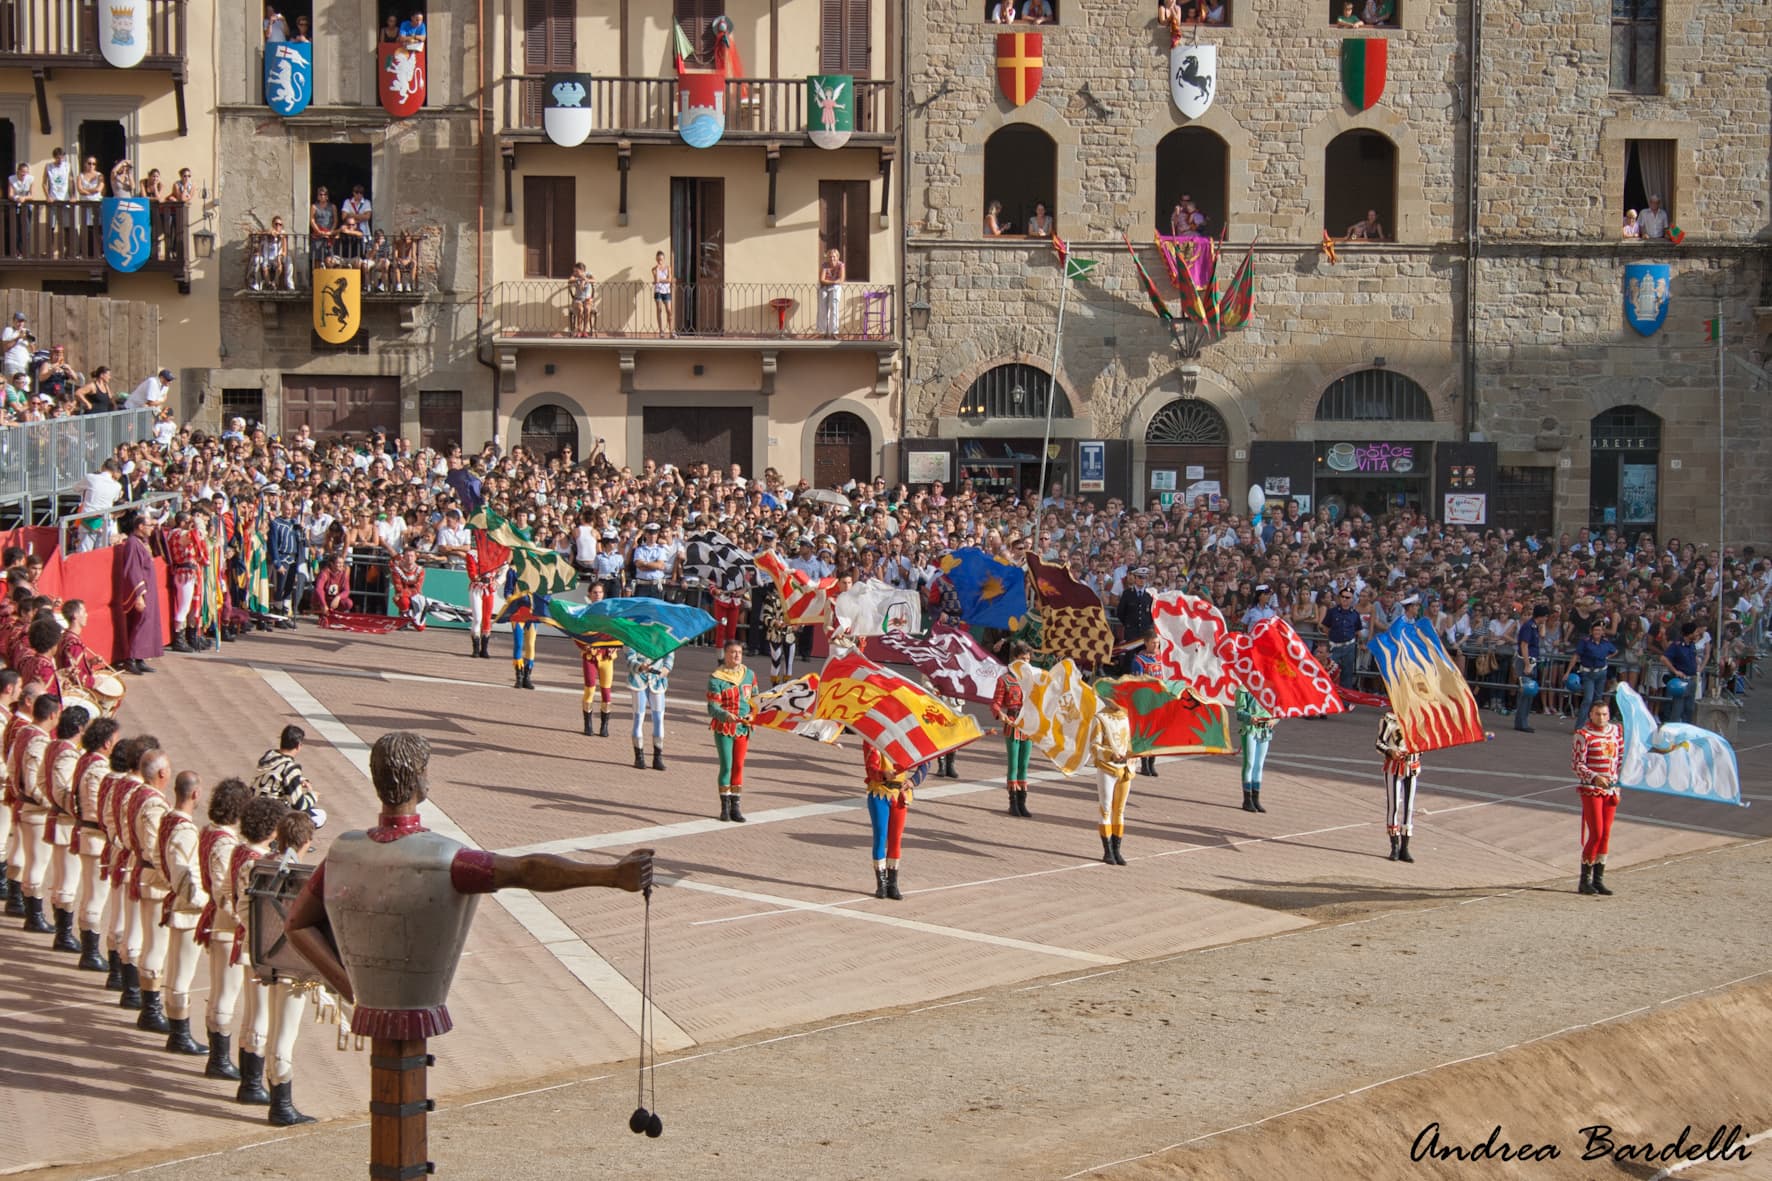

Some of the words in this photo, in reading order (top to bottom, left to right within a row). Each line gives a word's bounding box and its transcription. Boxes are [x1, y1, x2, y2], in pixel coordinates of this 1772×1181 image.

[1084, 447, 1100, 470] T
[1356, 447, 1414, 458] DOLCE
[1357, 457, 1390, 472] VITA
